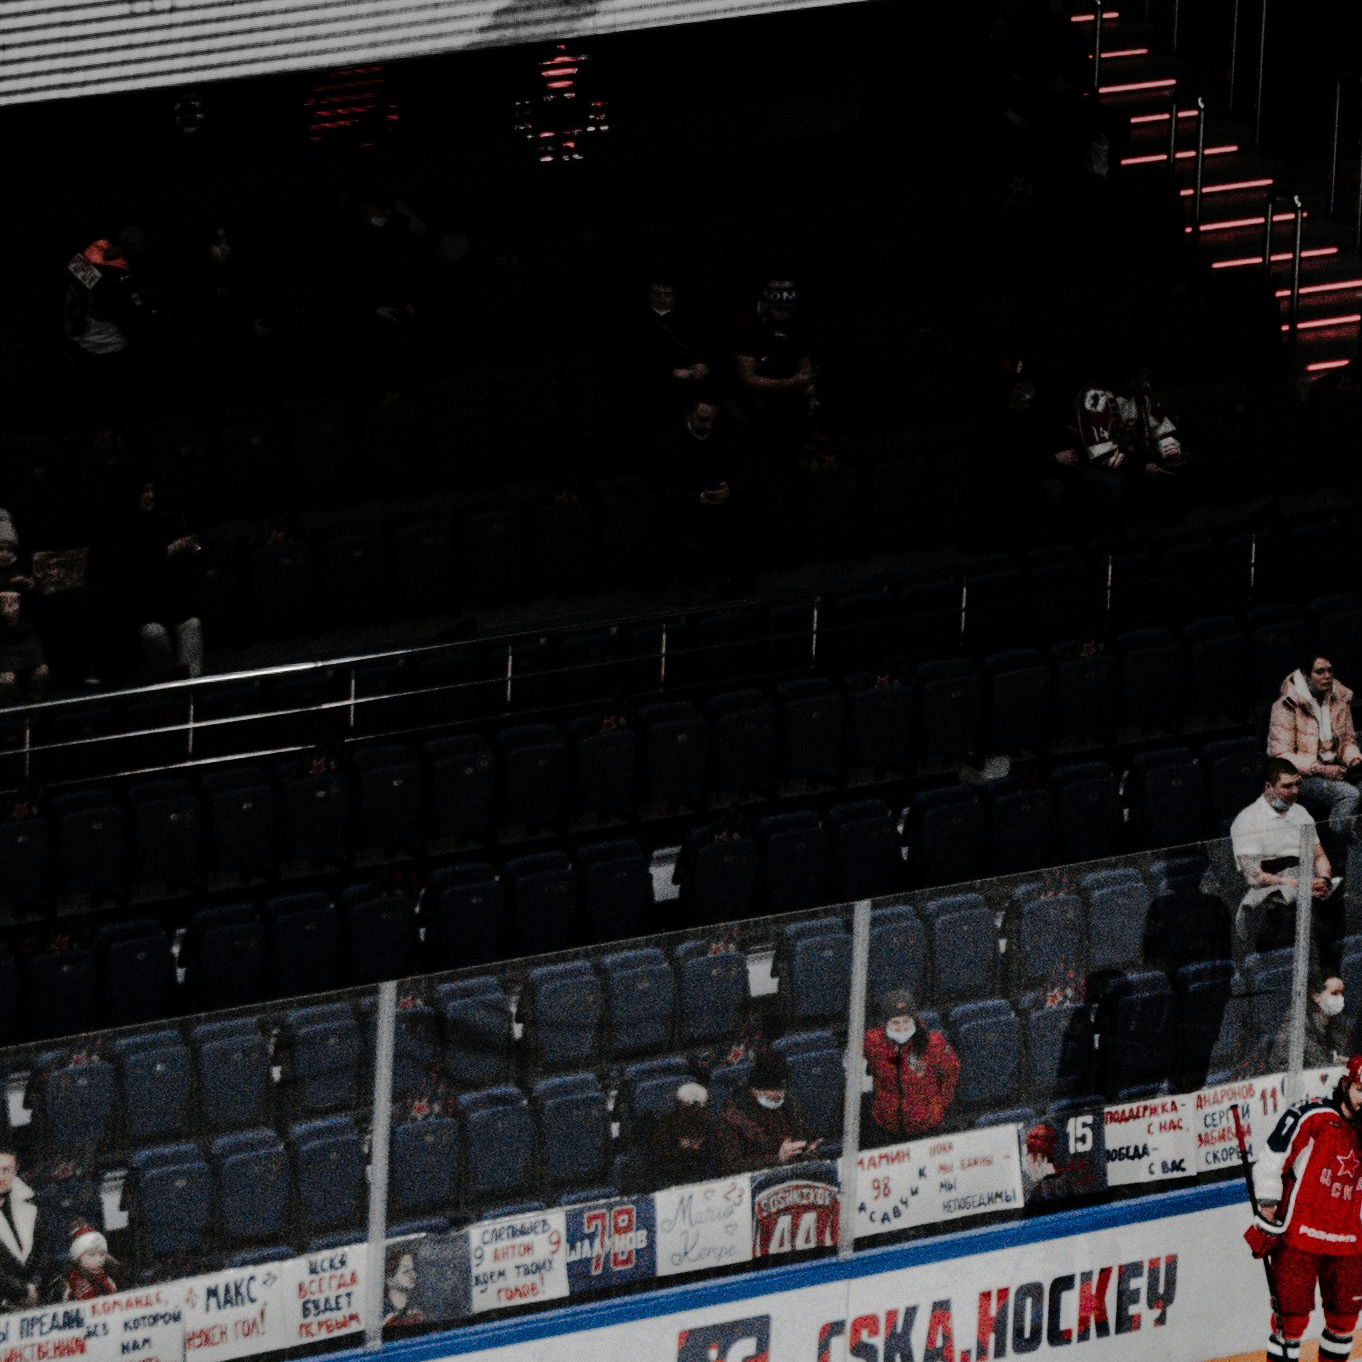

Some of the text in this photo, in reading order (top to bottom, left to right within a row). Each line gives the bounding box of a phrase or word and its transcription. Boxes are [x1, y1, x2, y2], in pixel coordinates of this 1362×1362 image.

[1259, 1086, 1278, 1116] 11
[1066, 1114, 1094, 1155] 15
[1160, 1157, 1187, 1174] ВАС
[871, 1176, 892, 1201] 98
[549, 1230, 562, 1256] 9
[584, 1204, 637, 1276] 78
[768, 1210, 818, 1255] 44
[205, 1274, 258, 1313] МАКС
